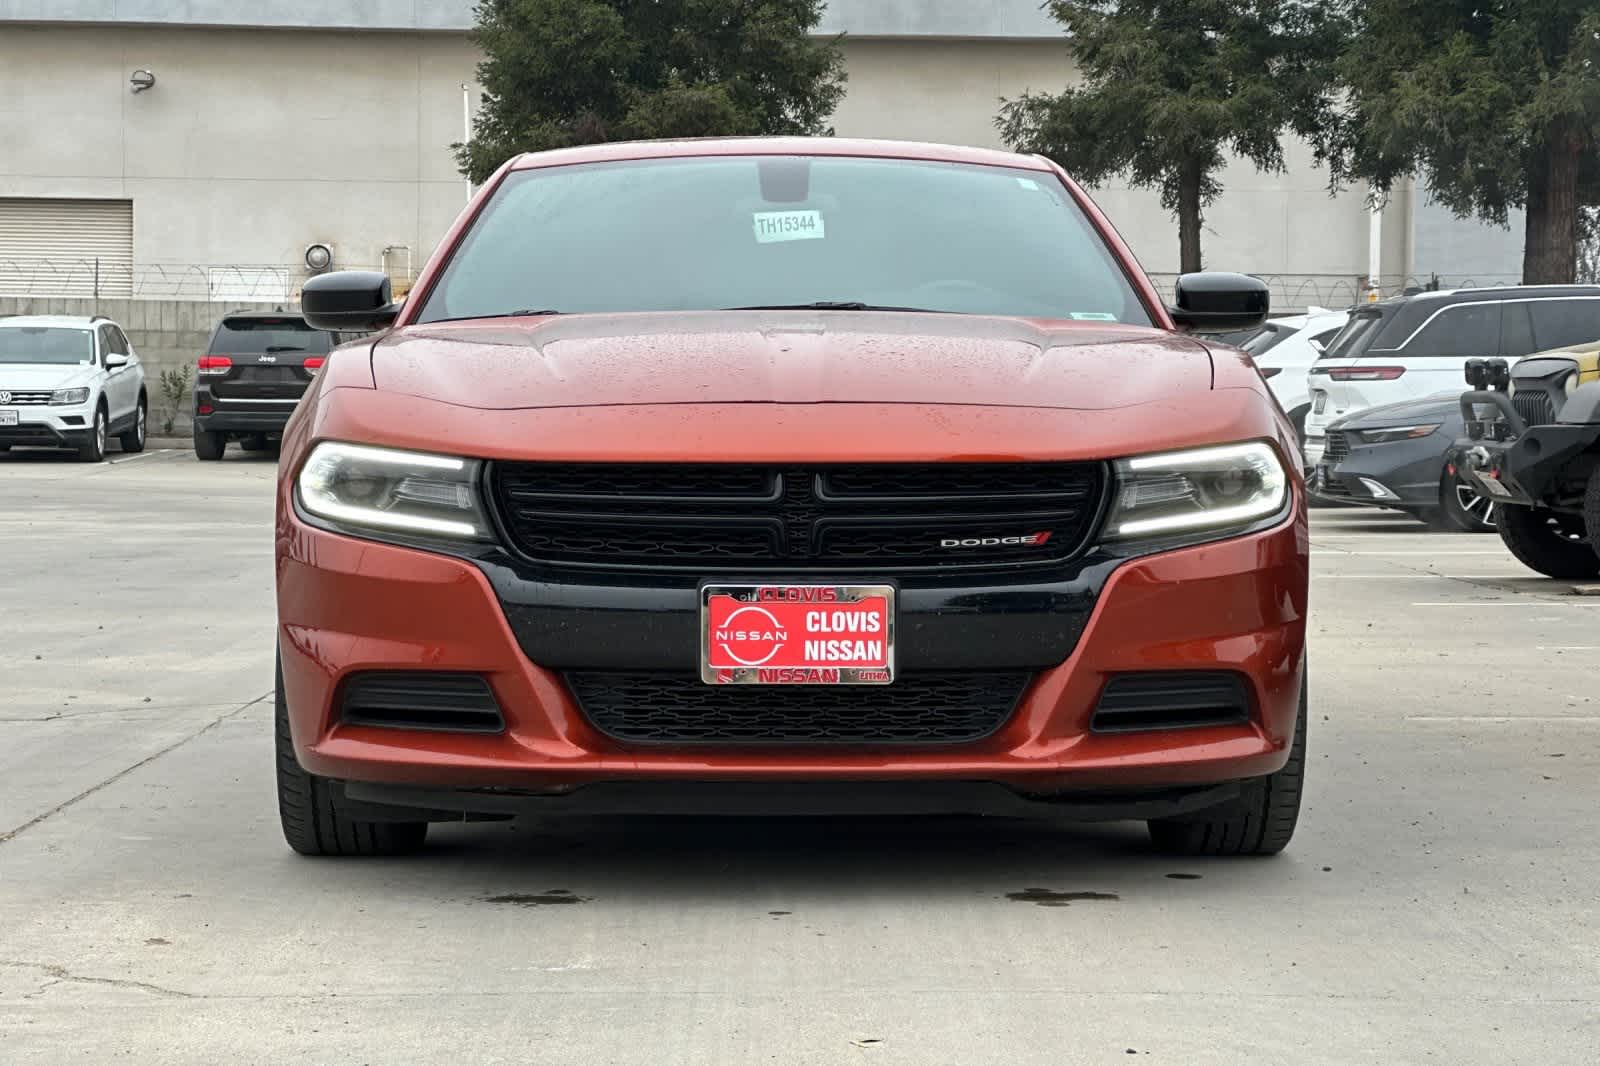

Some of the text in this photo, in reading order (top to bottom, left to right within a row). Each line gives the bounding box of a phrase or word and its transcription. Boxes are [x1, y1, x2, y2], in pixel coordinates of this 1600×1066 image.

[757, 215, 816, 233] TH15344
[258, 355, 276, 363] Jeep
[941, 535, 1038, 547] DODGE
[759, 587, 837, 601] CLOVIS
[806, 611, 881, 632] CLOVIS
[716, 631, 788, 641] NISSAN
[804, 640, 882, 661] NISSAN
[759, 668, 840, 683] NISSAN
